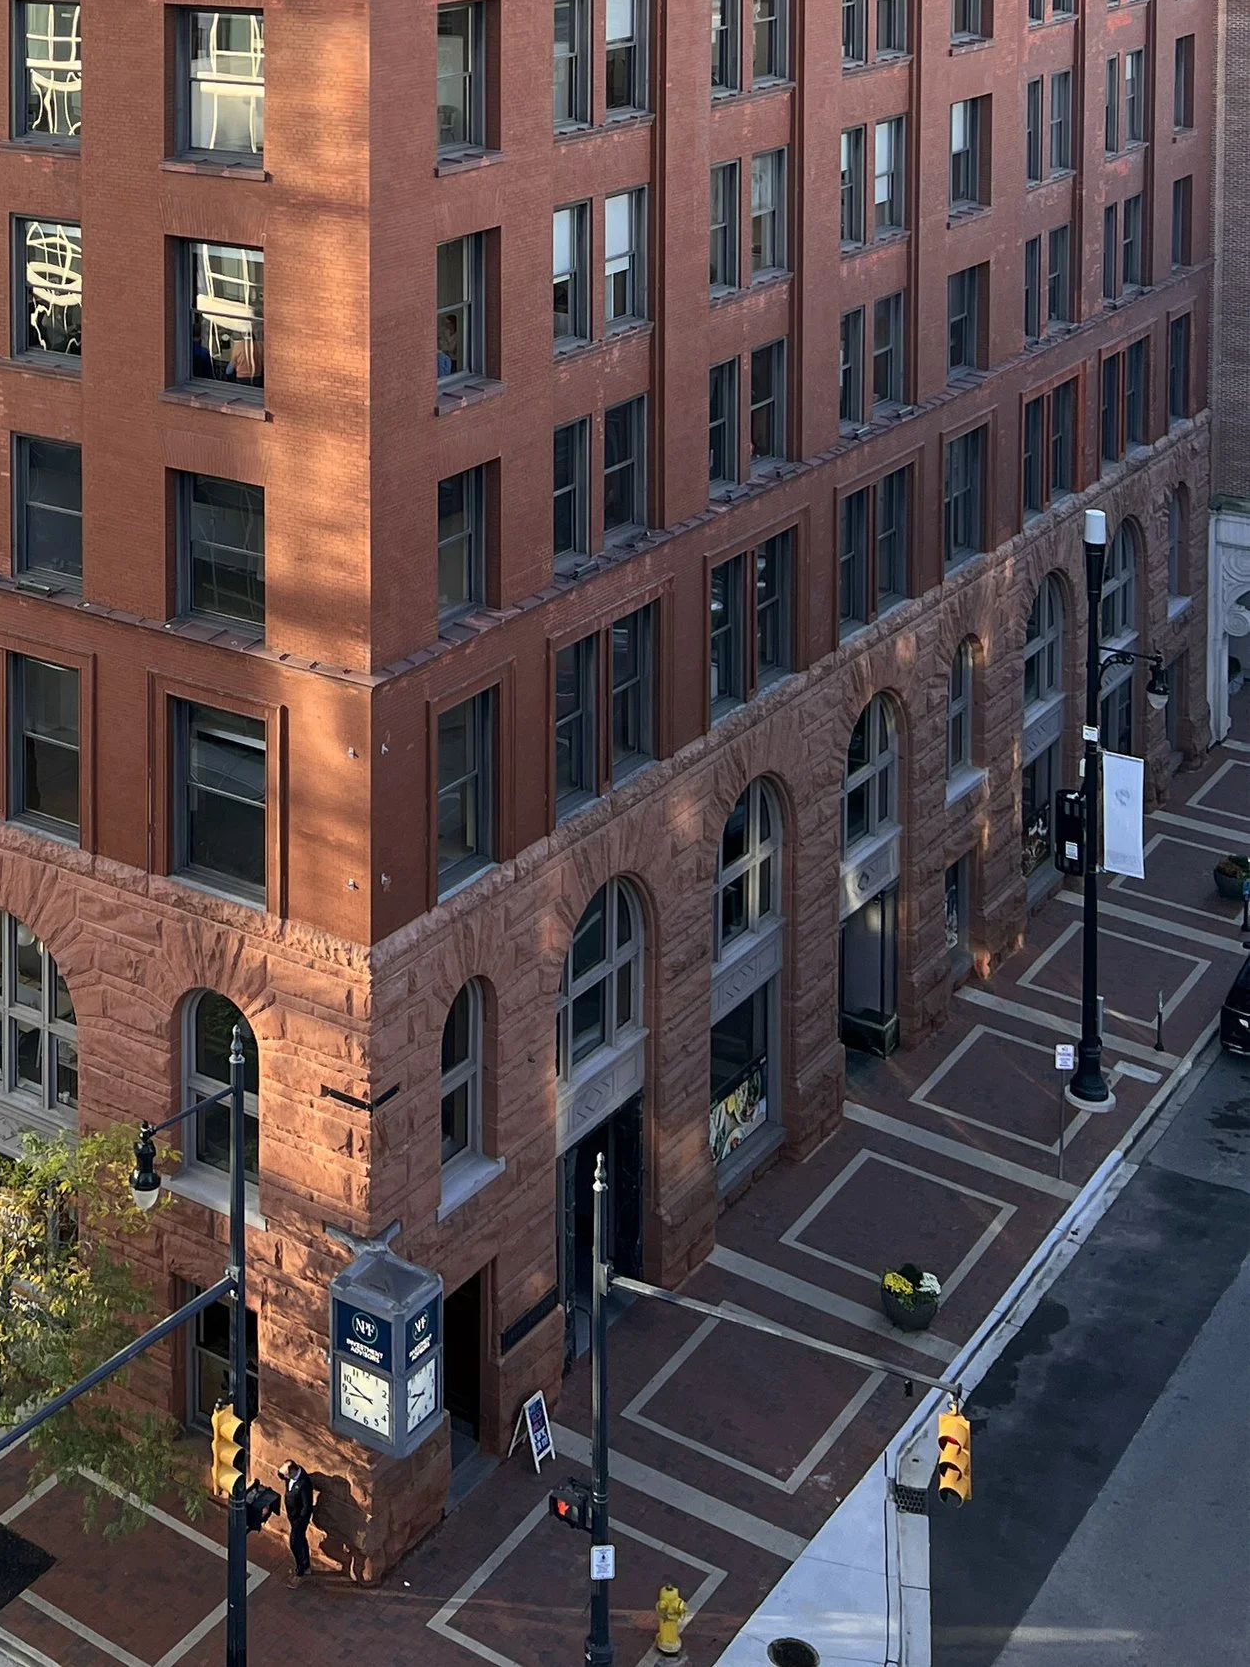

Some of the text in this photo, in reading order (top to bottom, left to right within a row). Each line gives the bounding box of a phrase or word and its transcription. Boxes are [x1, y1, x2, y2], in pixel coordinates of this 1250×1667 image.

[346, 1337, 384, 1360] INVESTMENT
[350, 1345, 381, 1364] ADVISORS
[343, 1374, 352, 1385] 10
[381, 1390, 387, 1399] 2
[345, 1397, 351, 1406] 8
[353, 1409, 359, 1417] 7
[363, 1416, 369, 1426] 6
[374, 1418, 379, 1427] 5
